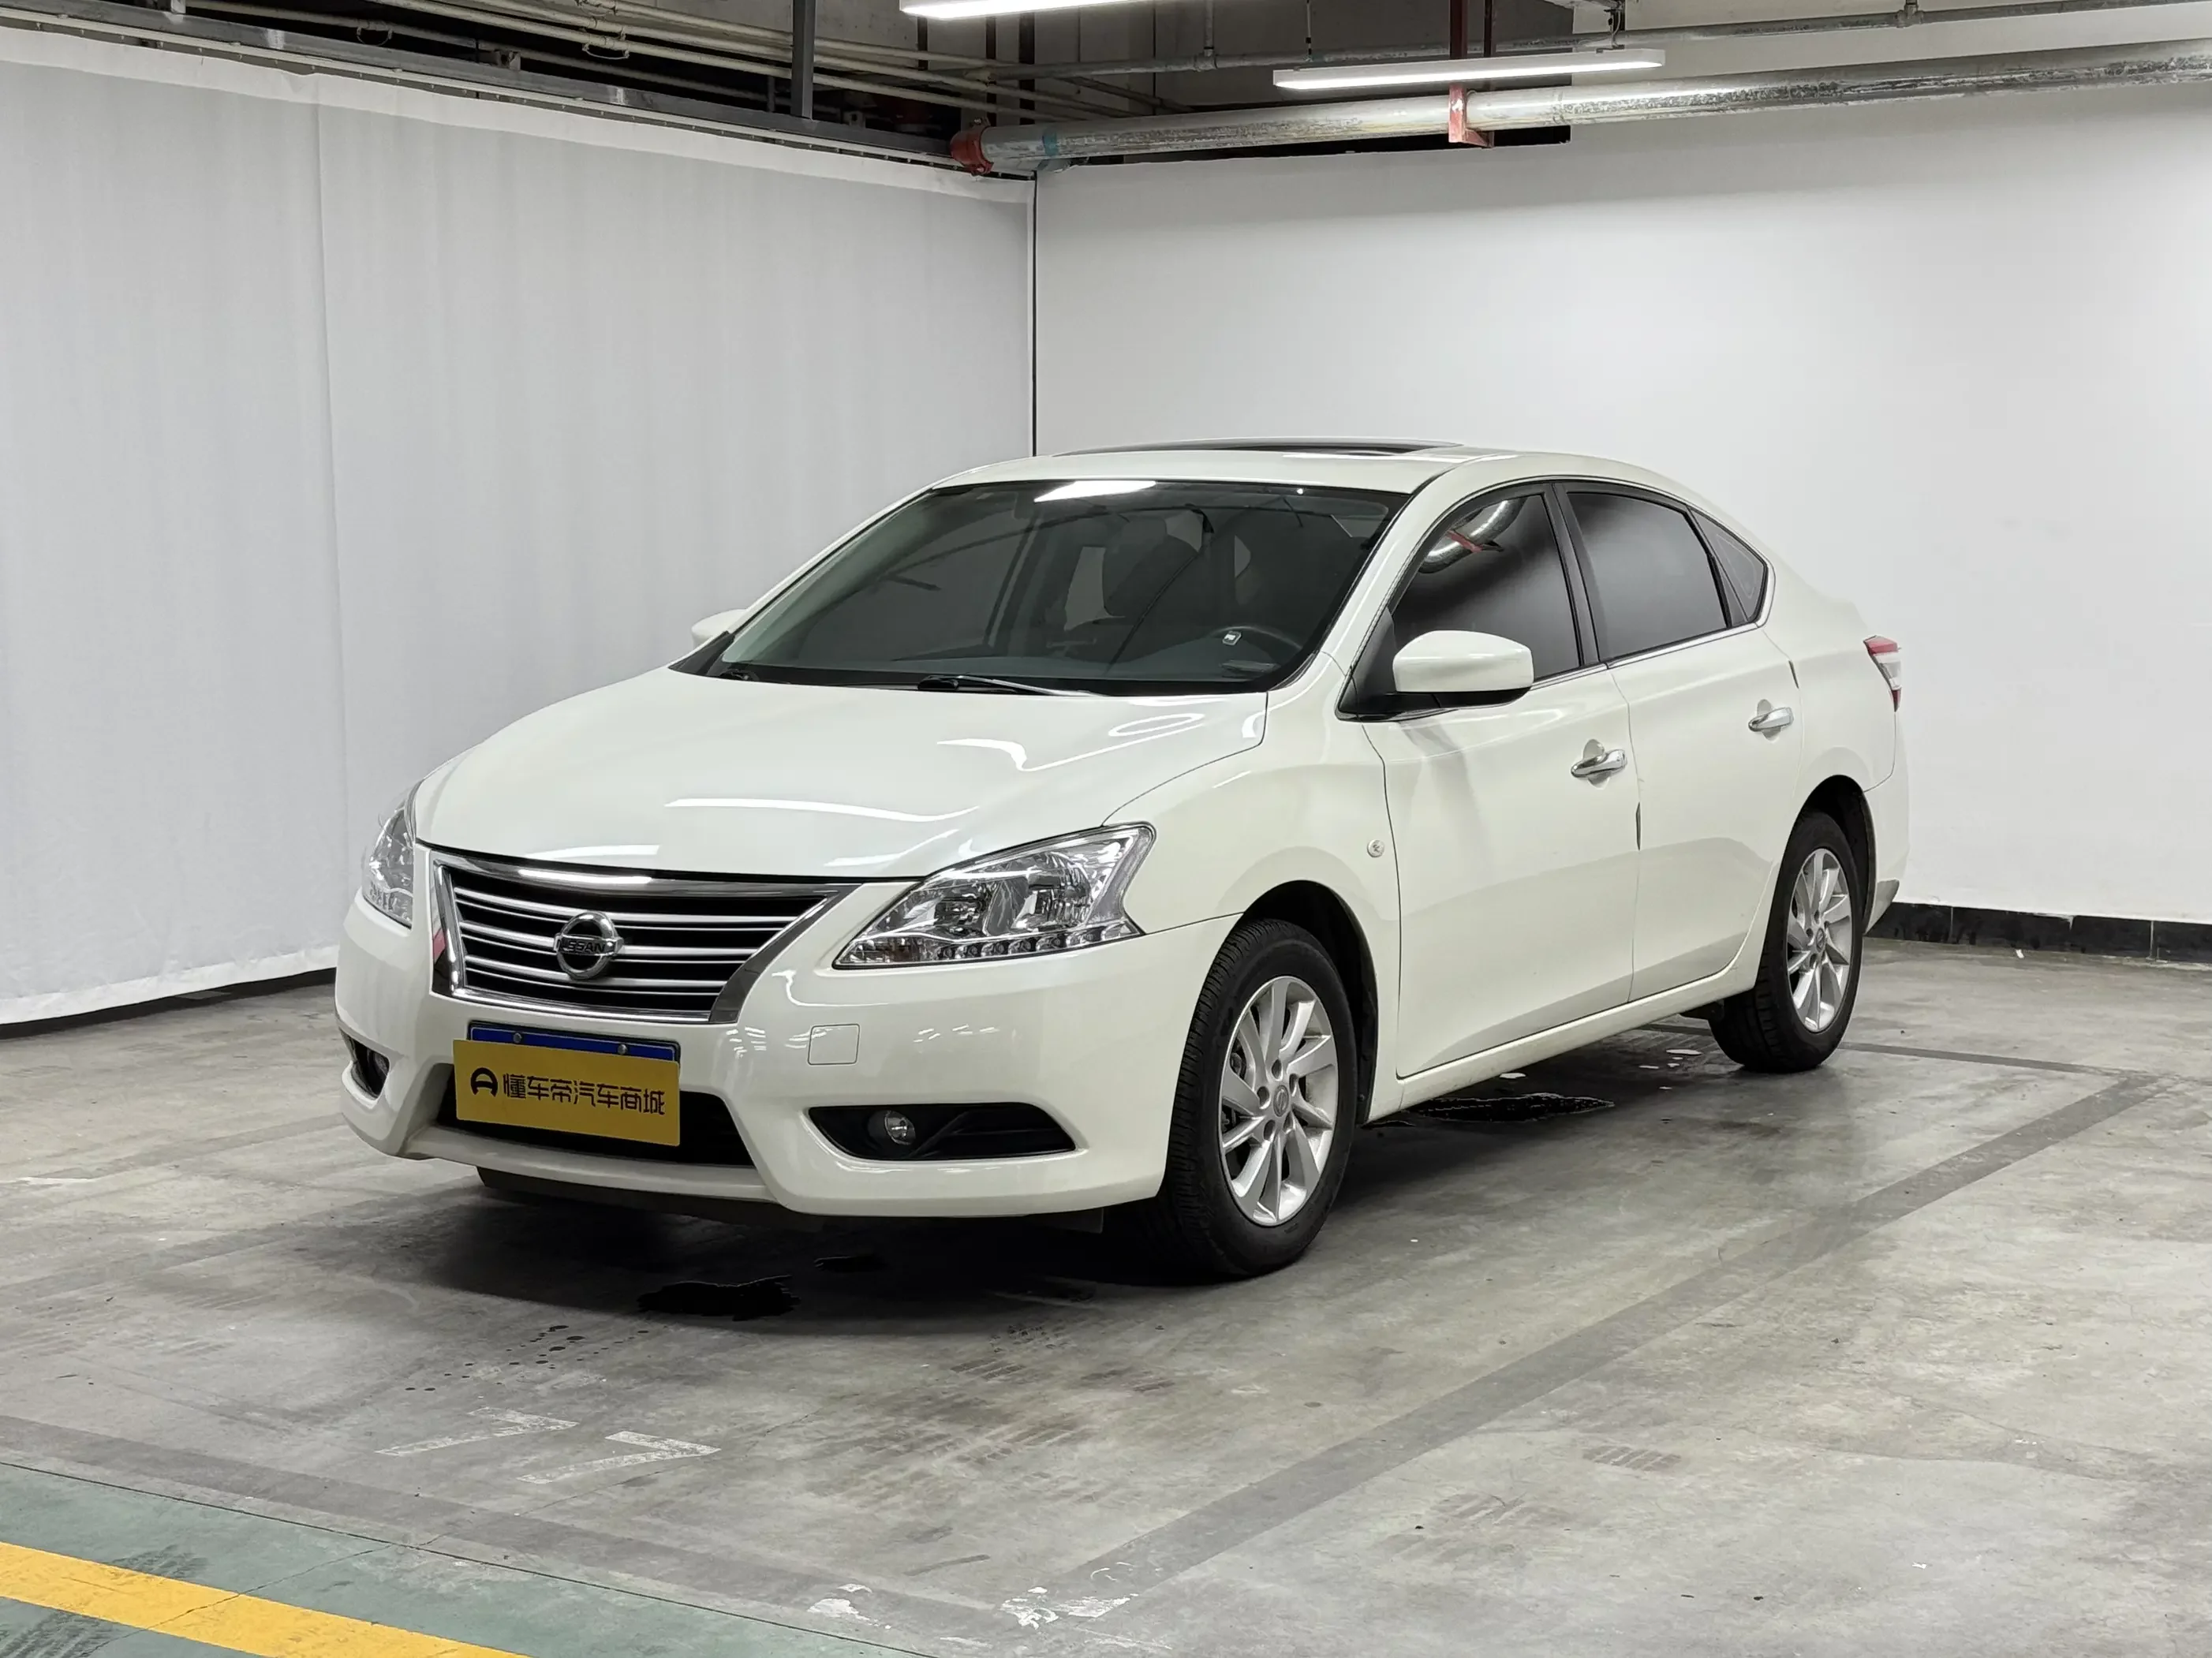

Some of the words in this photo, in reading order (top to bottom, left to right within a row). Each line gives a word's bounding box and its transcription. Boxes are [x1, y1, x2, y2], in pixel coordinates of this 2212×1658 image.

[503, 1073, 665, 1115] 懂车帝汽车商城
